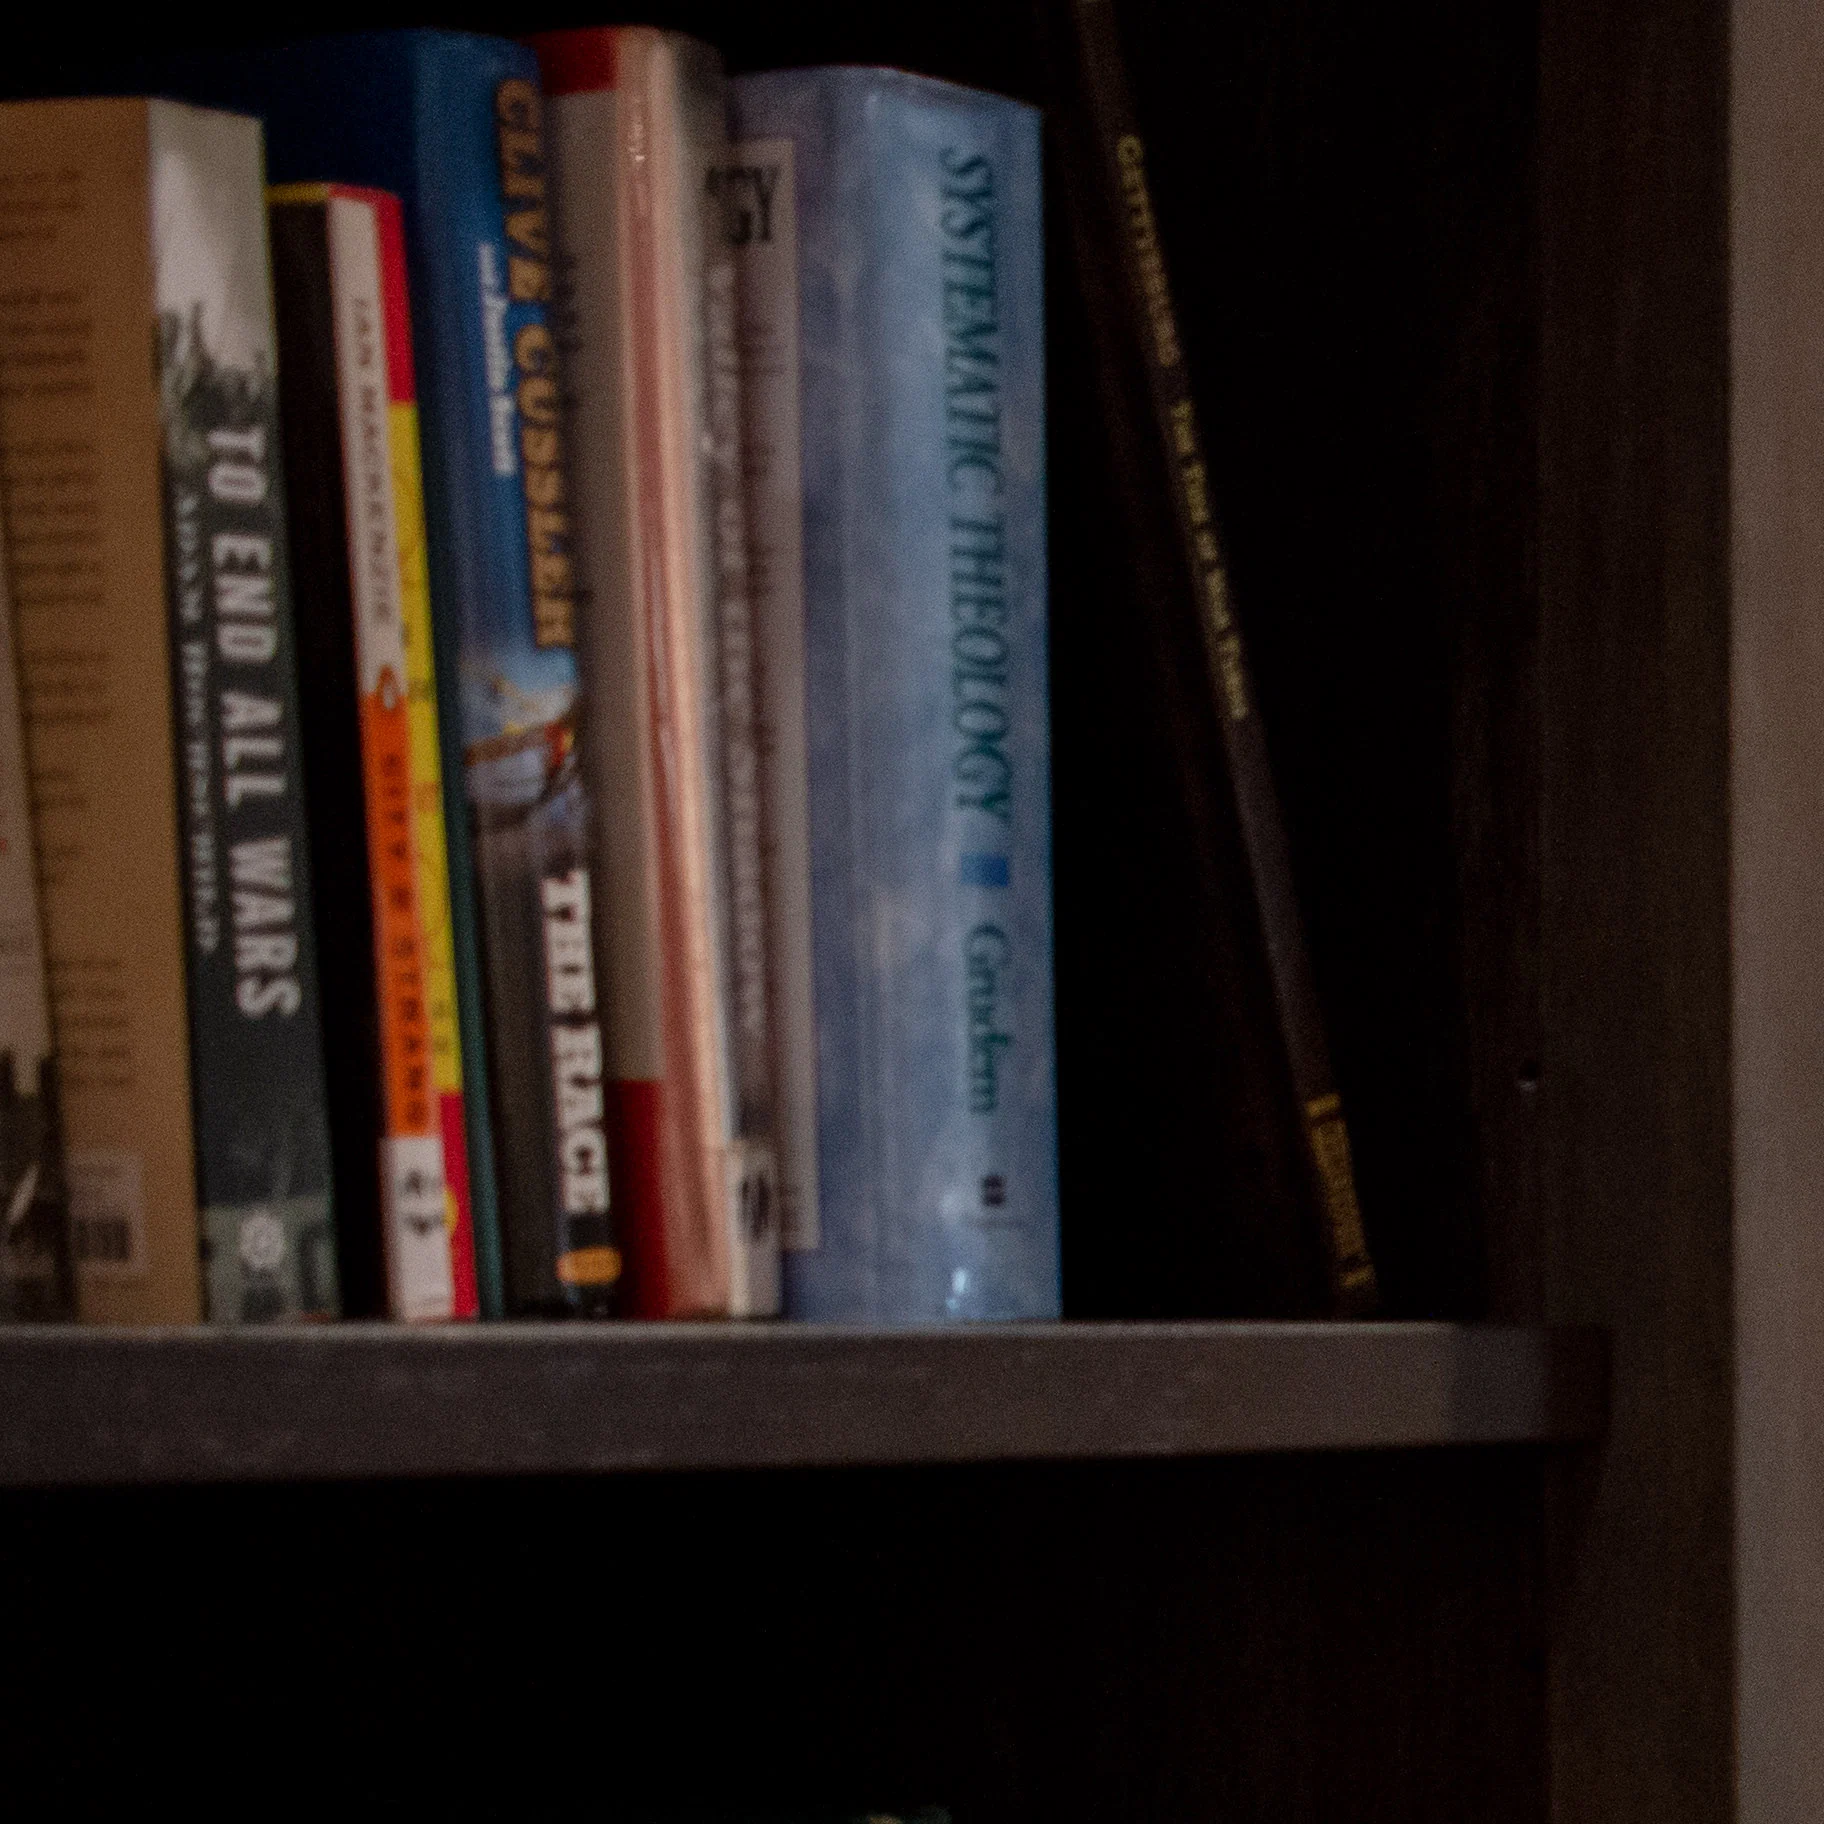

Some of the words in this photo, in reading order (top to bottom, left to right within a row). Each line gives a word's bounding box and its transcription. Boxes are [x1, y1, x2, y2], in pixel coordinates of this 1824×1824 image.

[495, 79, 555, 299] CLIVE
[938, 147, 1006, 495] SYSTEMATIC
[207, 424, 266, 497] TO
[512, 325, 578, 650] CUSSLER
[210, 534, 278, 663] END
[949, 516, 1013, 825] THEOLOGY
[219, 693, 291, 804] ALL
[232, 837, 302, 1018] WARS
[540, 870, 597, 1015] THE
[962, 923, 1008, 1115] Grudem
[553, 1028, 611, 1215] RACE
